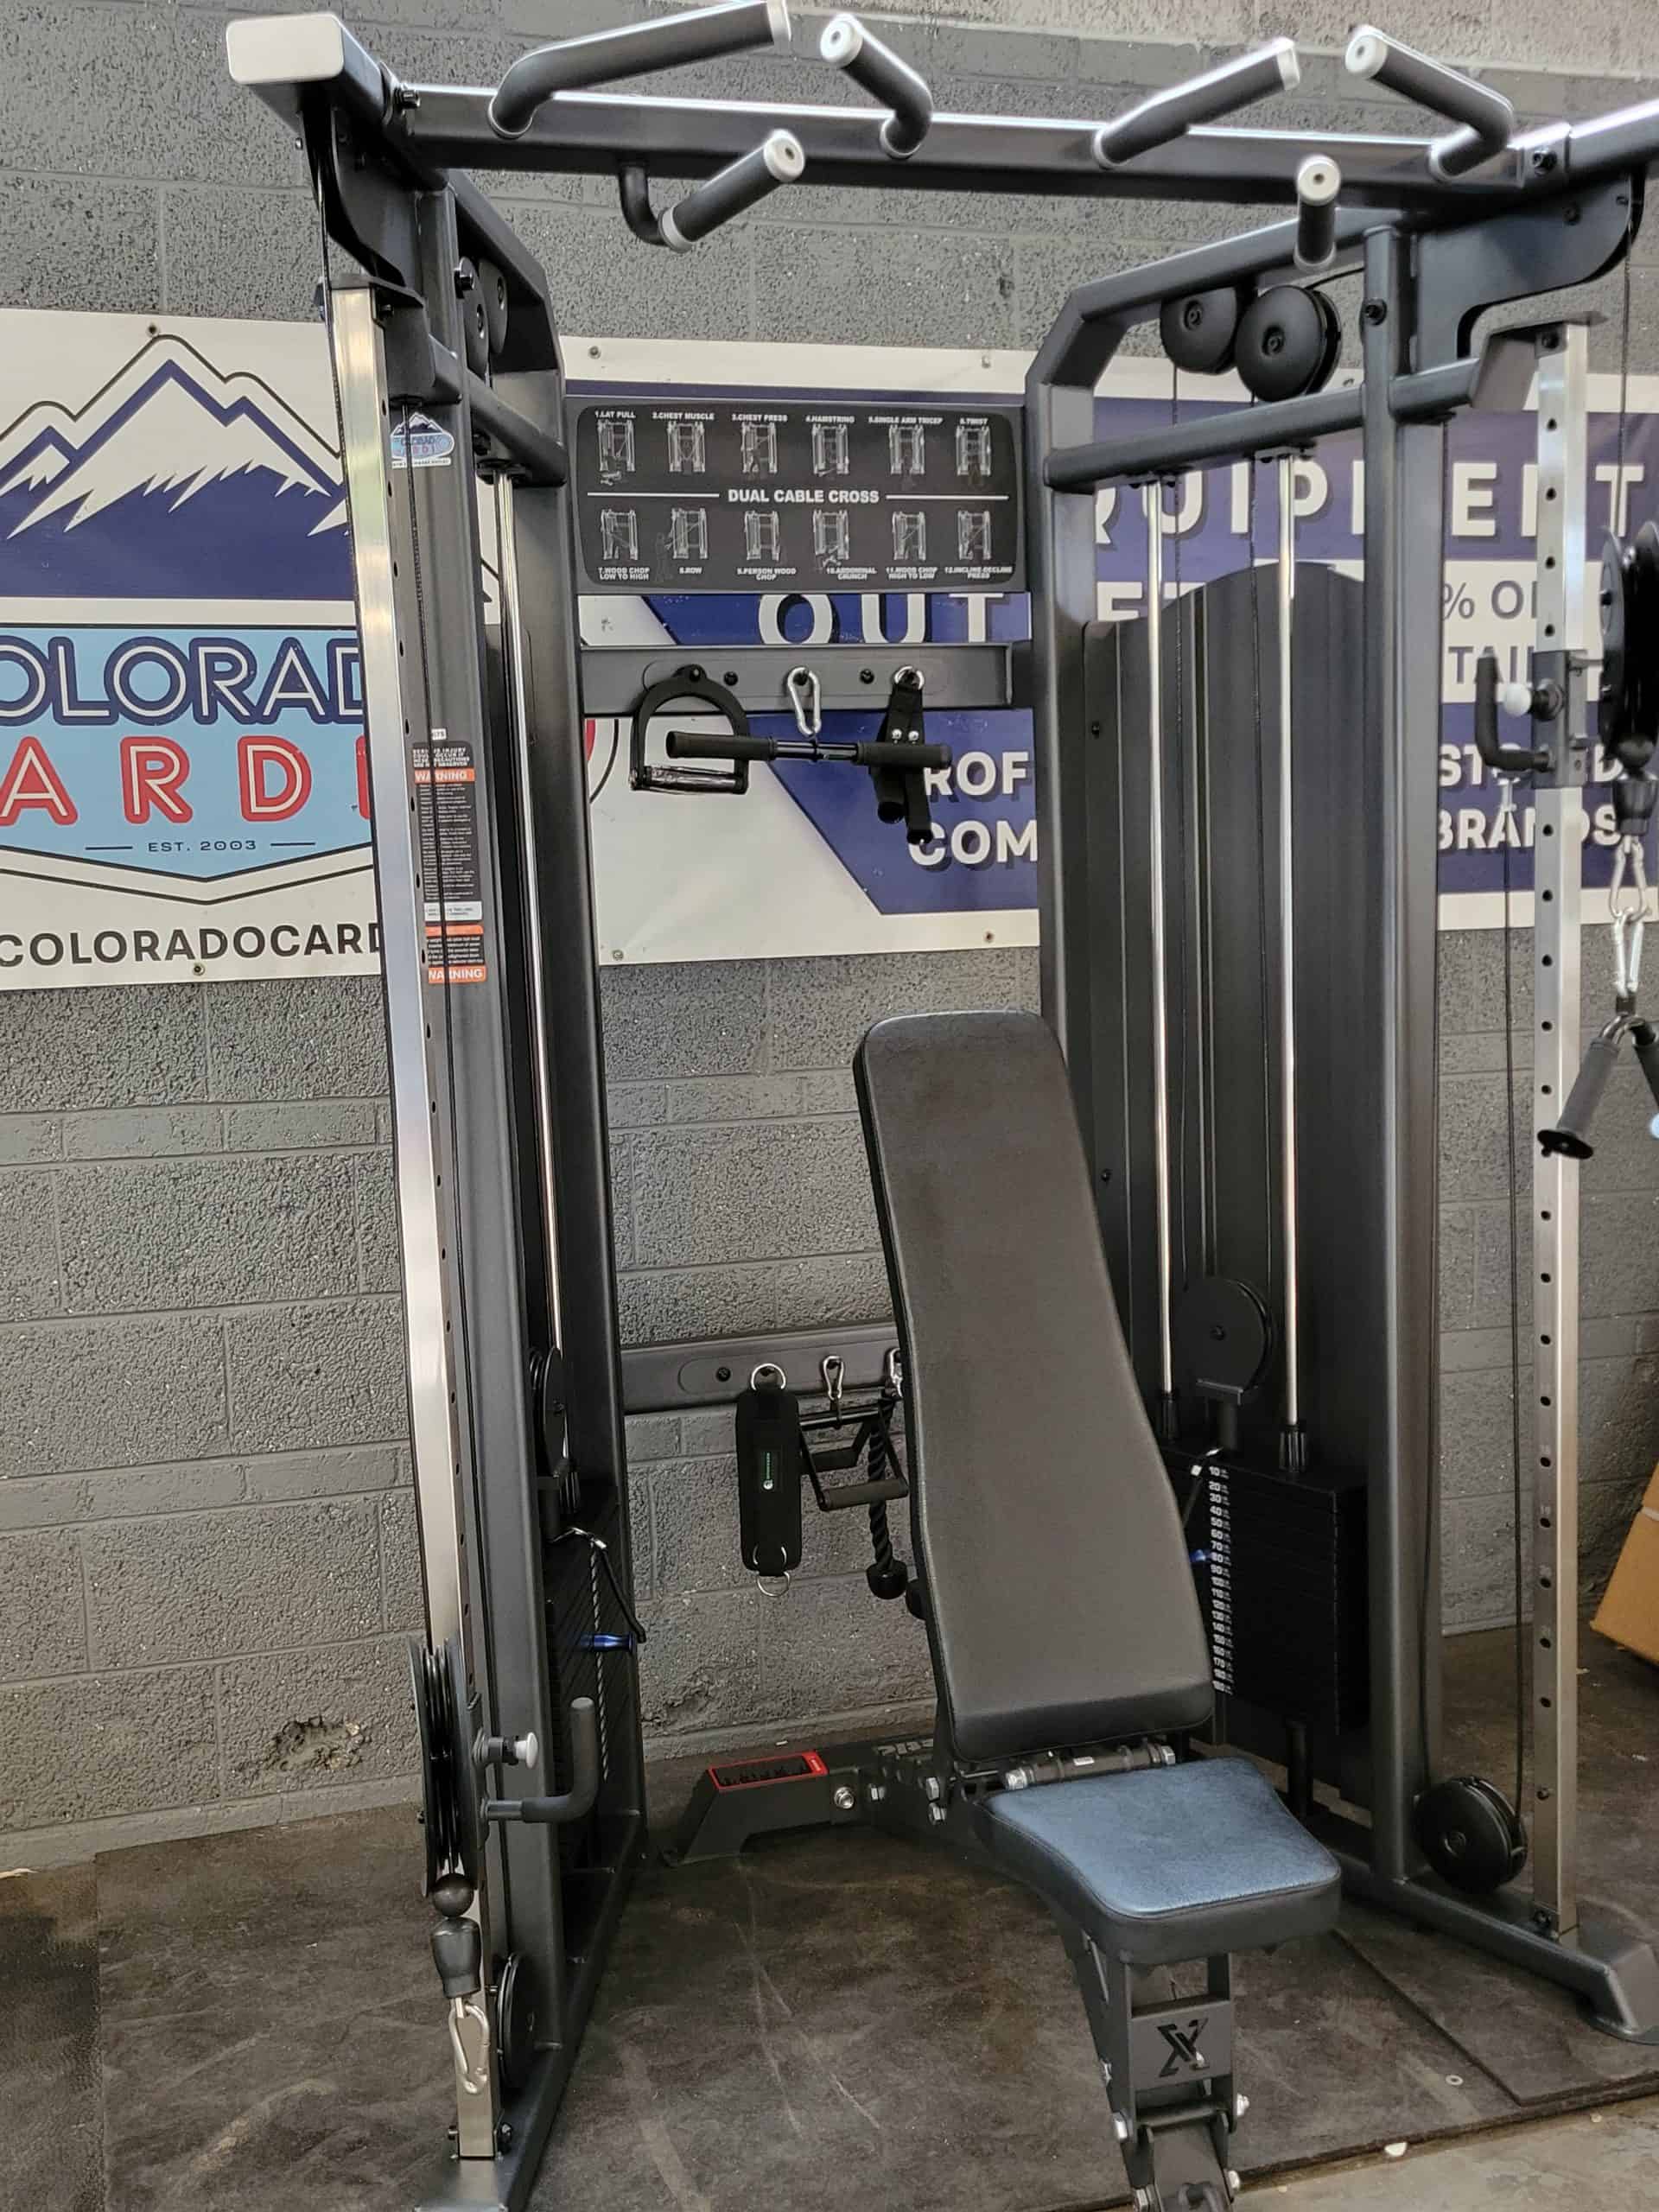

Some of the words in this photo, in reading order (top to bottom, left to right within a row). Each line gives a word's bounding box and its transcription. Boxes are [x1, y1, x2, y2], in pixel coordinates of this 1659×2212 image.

[728, 488, 770, 502] DUAL
[773, 489, 825, 503] CABLE
[828, 490, 880, 503] CROSS
[148, 842, 191, 853] EST.
[200, 839, 257, 852] 2003
[428, 968, 483, 982] WANING
[1211, 1541, 1224, 1552] 70
